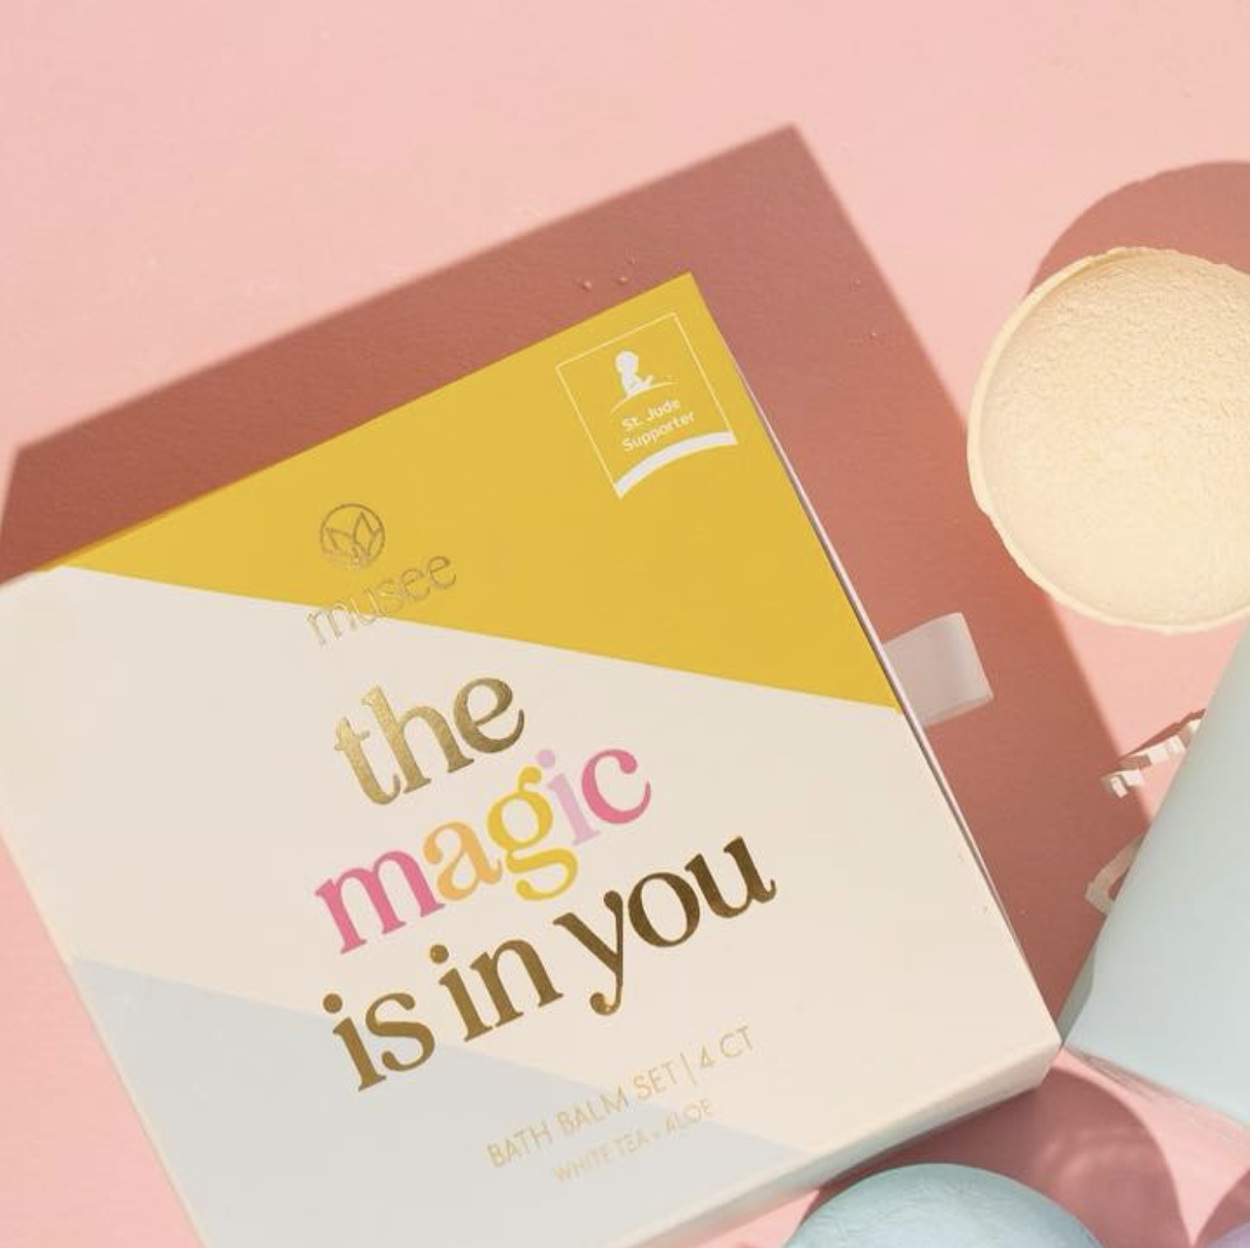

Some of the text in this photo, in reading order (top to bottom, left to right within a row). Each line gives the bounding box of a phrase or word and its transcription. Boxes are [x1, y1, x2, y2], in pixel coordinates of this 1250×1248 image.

[622, 398, 681, 432] St. Jude
[622, 411, 695, 452] Supporter
[306, 554, 458, 646] musee
[334, 677, 525, 806] the
[314, 748, 651, 955] magic
[322, 835, 777, 1093] is in you
[487, 1120, 554, 1170] BATH
[554, 1085, 629, 1139] BALM
[632, 1060, 679, 1101] SET
[698, 1045, 716, 1071] 4
[719, 1025, 754, 1058] CT
[554, 1149, 613, 1183] WHITE
[614, 1130, 650, 1157] TEA
[664, 1098, 713, 1136] ALOE
